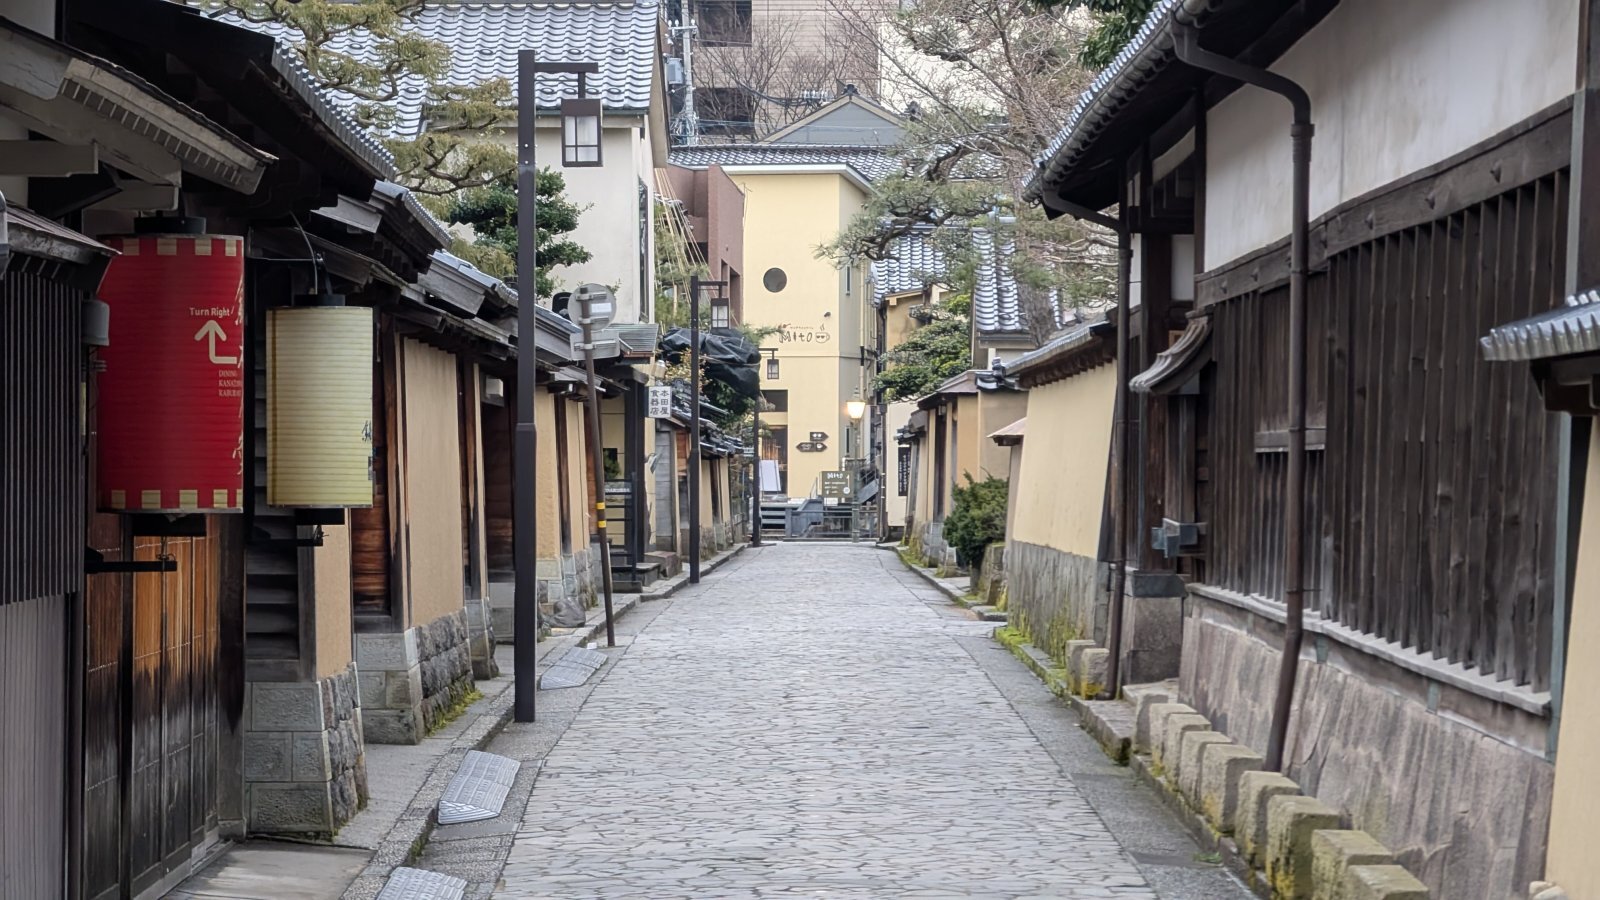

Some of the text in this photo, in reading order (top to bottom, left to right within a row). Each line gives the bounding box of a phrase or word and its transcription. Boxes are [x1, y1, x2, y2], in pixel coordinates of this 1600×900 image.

[189, 307, 230, 318] Turn Right
[660, 389, 669, 415] 本田屋
